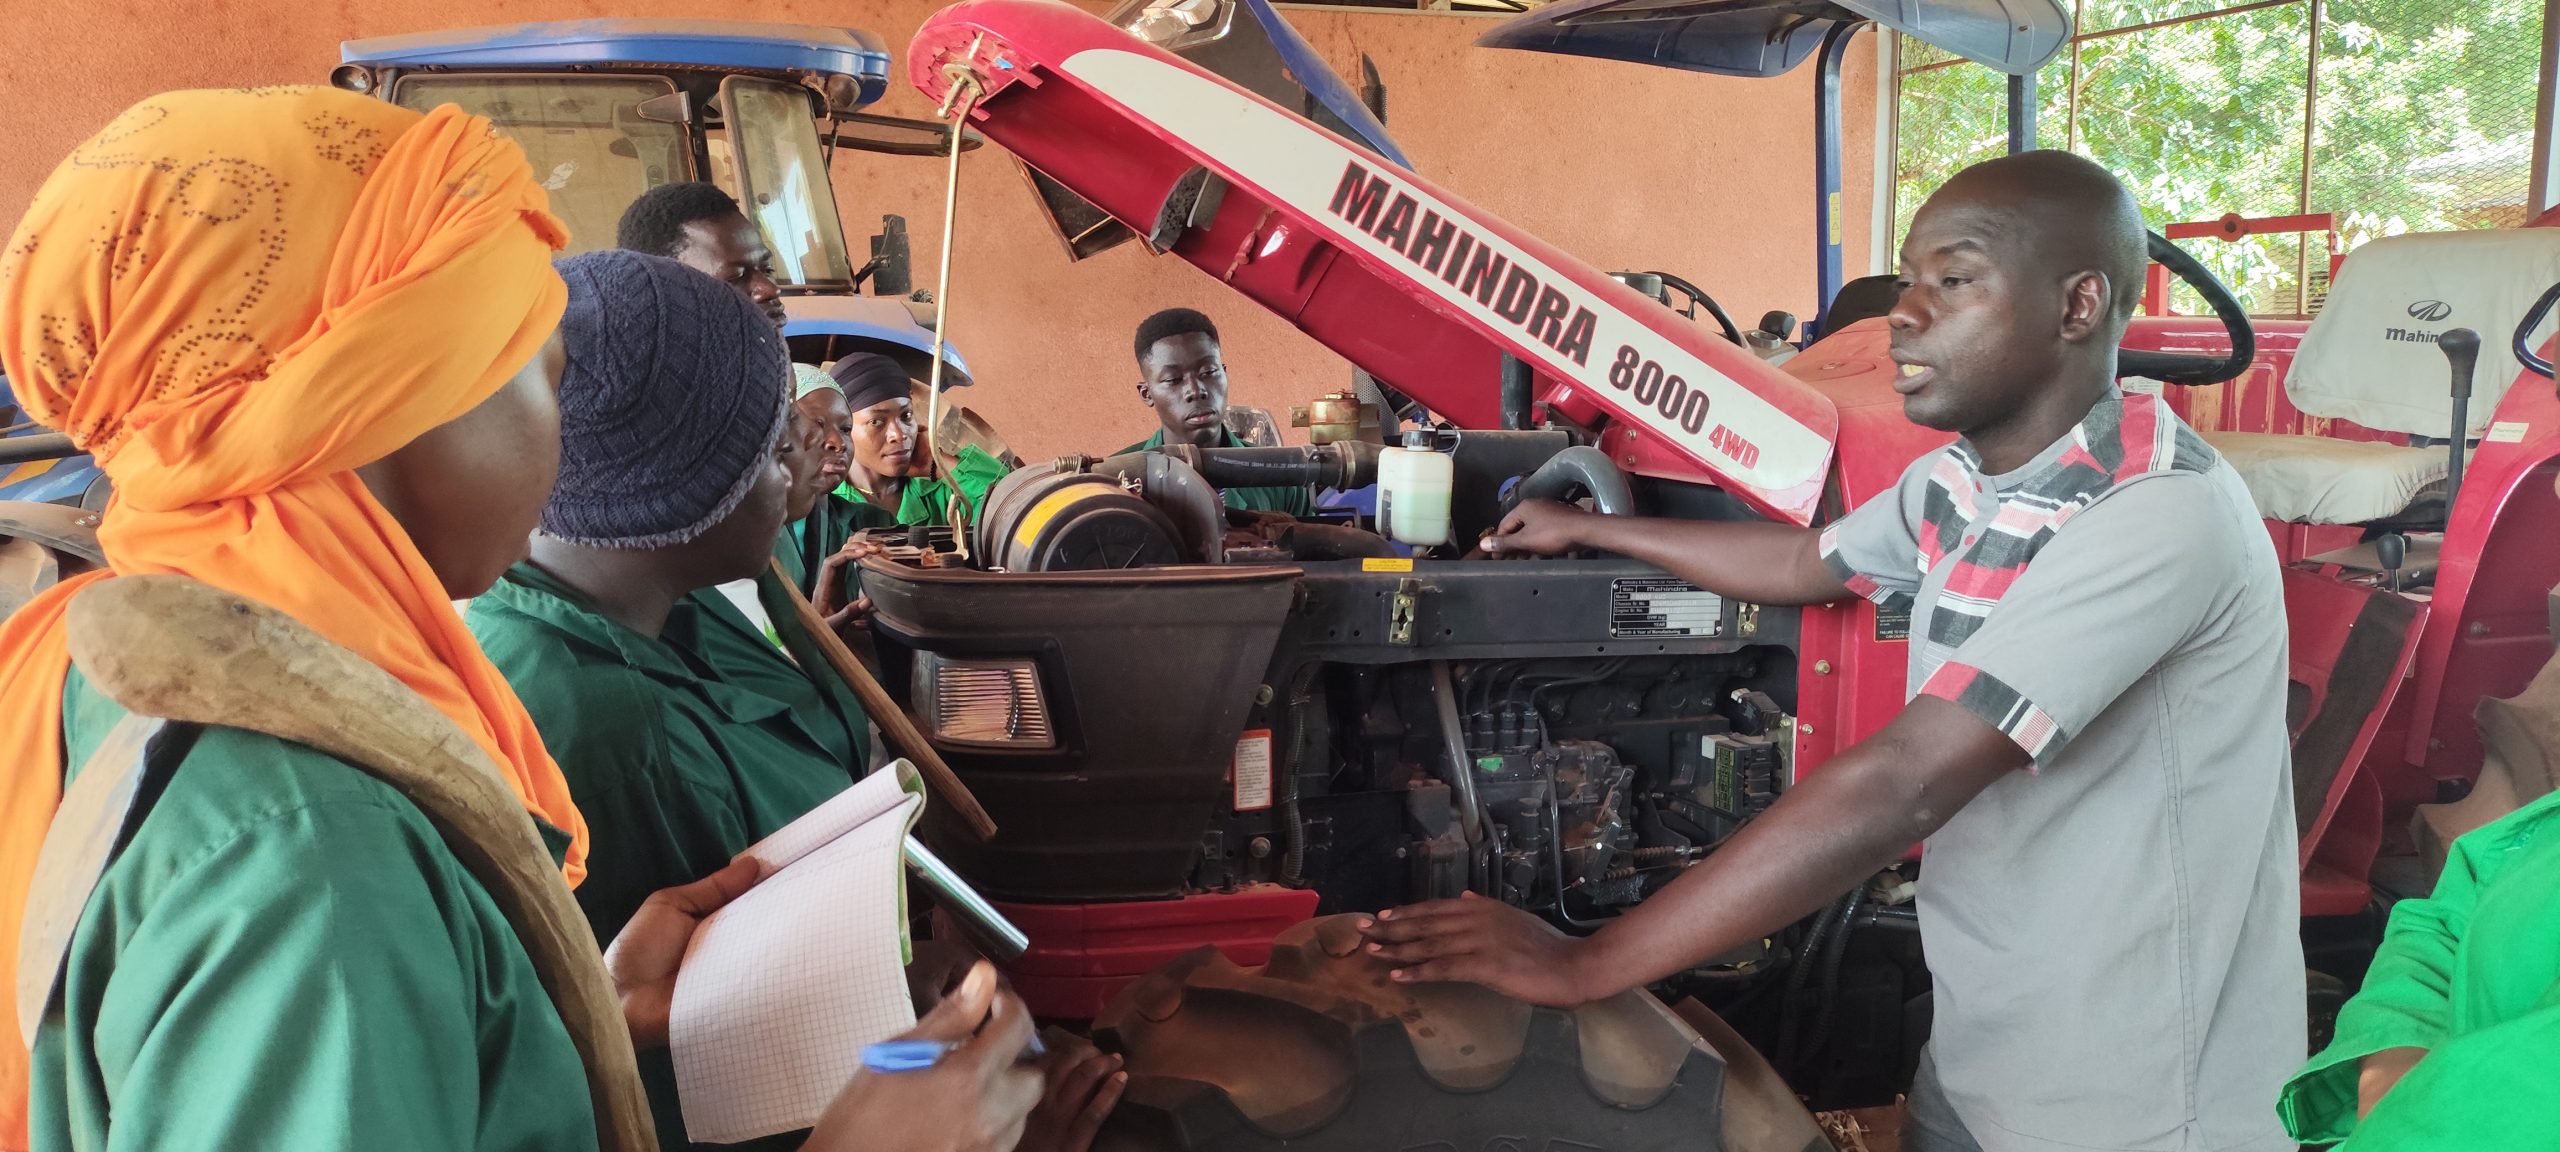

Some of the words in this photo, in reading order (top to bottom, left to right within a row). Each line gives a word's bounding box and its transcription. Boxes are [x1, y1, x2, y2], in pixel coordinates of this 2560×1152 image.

[1329, 159, 1598, 369] MAHINDRA
[1608, 344, 1711, 436] 8000
[1709, 423, 1761, 470] 4WD
[2386, 328, 2439, 343] mahin
